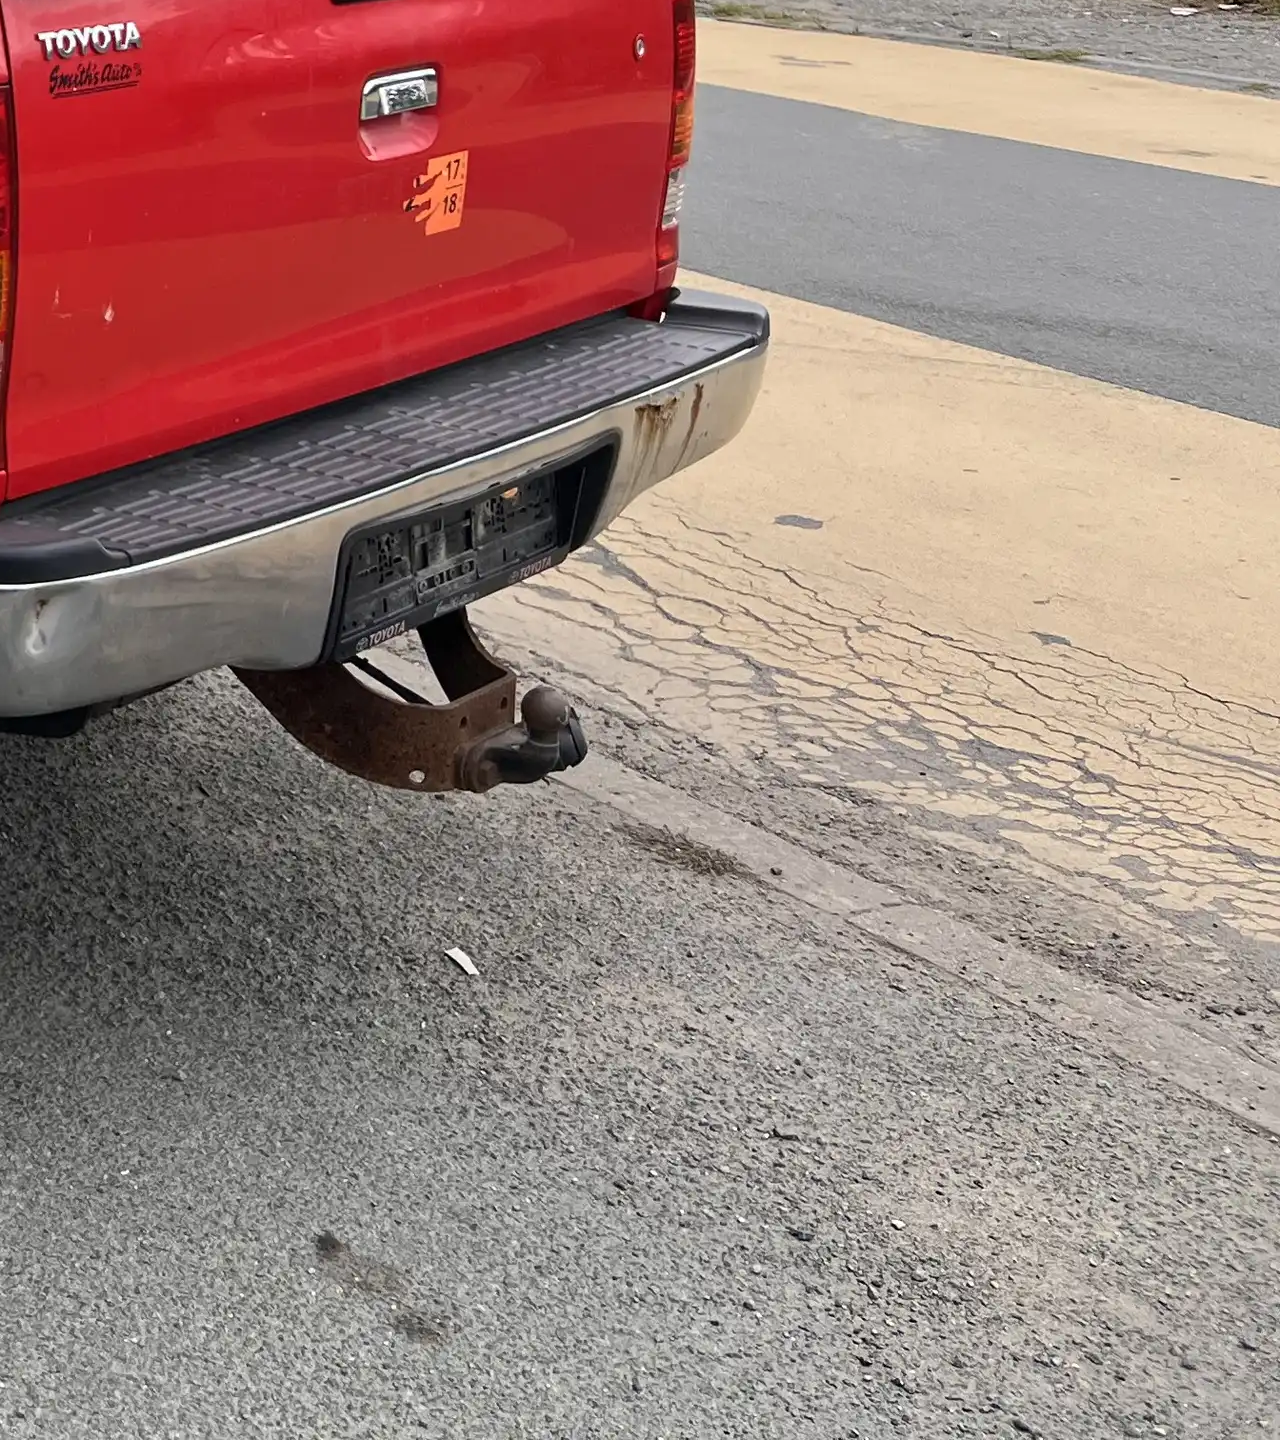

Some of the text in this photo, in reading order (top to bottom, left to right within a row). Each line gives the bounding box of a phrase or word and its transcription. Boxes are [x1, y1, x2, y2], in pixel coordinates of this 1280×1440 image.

[36, 21, 143, 60] TOYOTA
[446, 158, 461, 181] 17
[443, 193, 458, 215] 18
[519, 555, 552, 580] TOYOTA
[368, 620, 406, 648] TOYOTA
